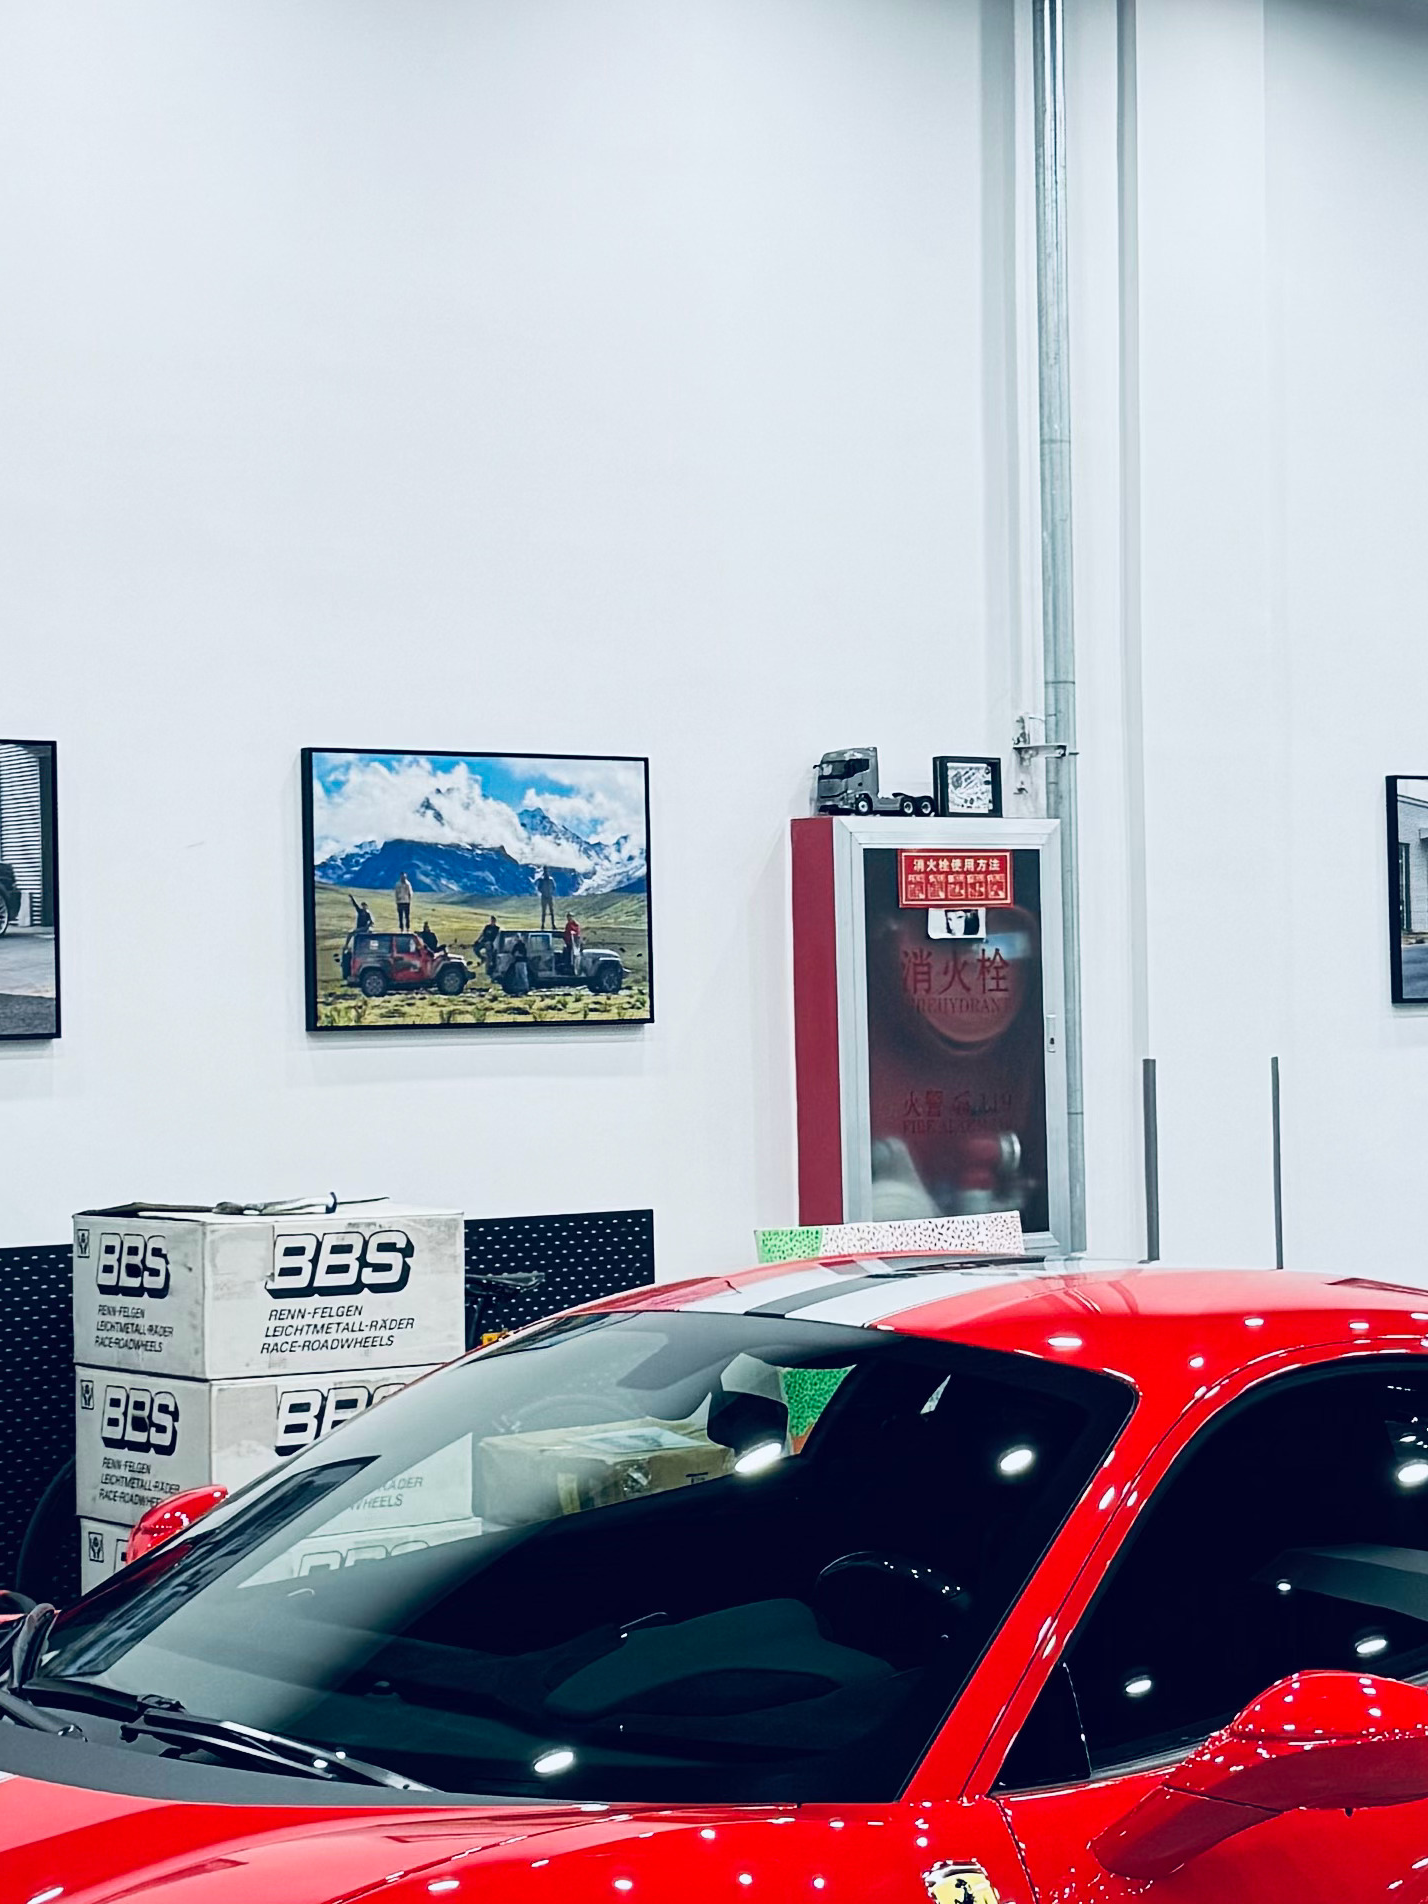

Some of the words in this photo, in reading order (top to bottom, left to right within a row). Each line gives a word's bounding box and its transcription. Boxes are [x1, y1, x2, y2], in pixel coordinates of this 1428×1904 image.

[913, 858, 1000, 872] 消火栓使用方法
[901, 948, 1009, 995] 消火栓
[96, 1232, 170, 1299] BBS
[264, 1230, 415, 1299] BBS
[265, 1318, 415, 1337] LEICHTMETALL-RÄDER
[268, 1305, 363, 1321] RENN-FELGEN
[260, 1335, 394, 1354] RACE-ROADWHEELS
[101, 1385, 180, 1456] BBS
[275, 1383, 407, 1456] BB
